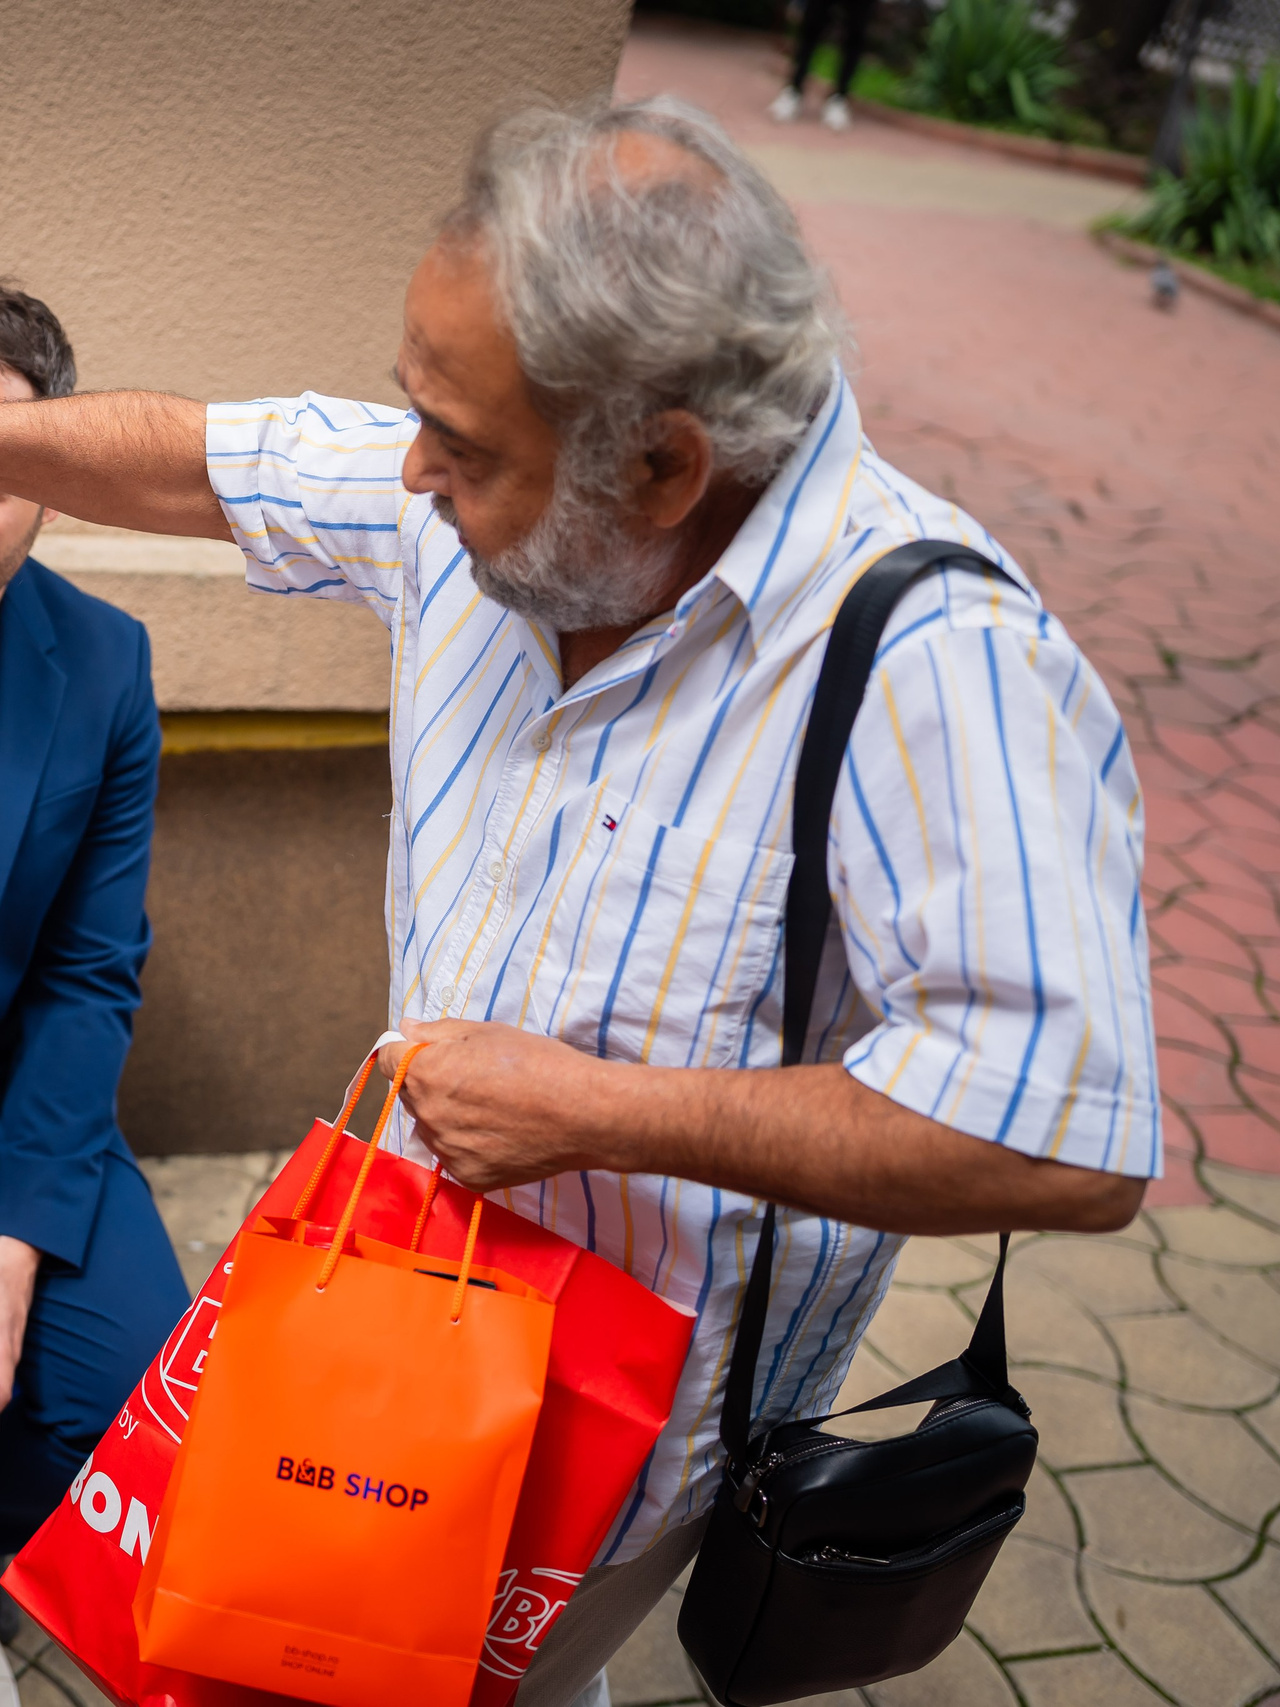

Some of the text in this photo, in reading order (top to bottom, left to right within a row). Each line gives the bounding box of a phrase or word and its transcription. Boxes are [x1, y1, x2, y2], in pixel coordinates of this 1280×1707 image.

[118, 1401, 139, 1439] by
[276, 1456, 429, 1511] B&B SHOP
